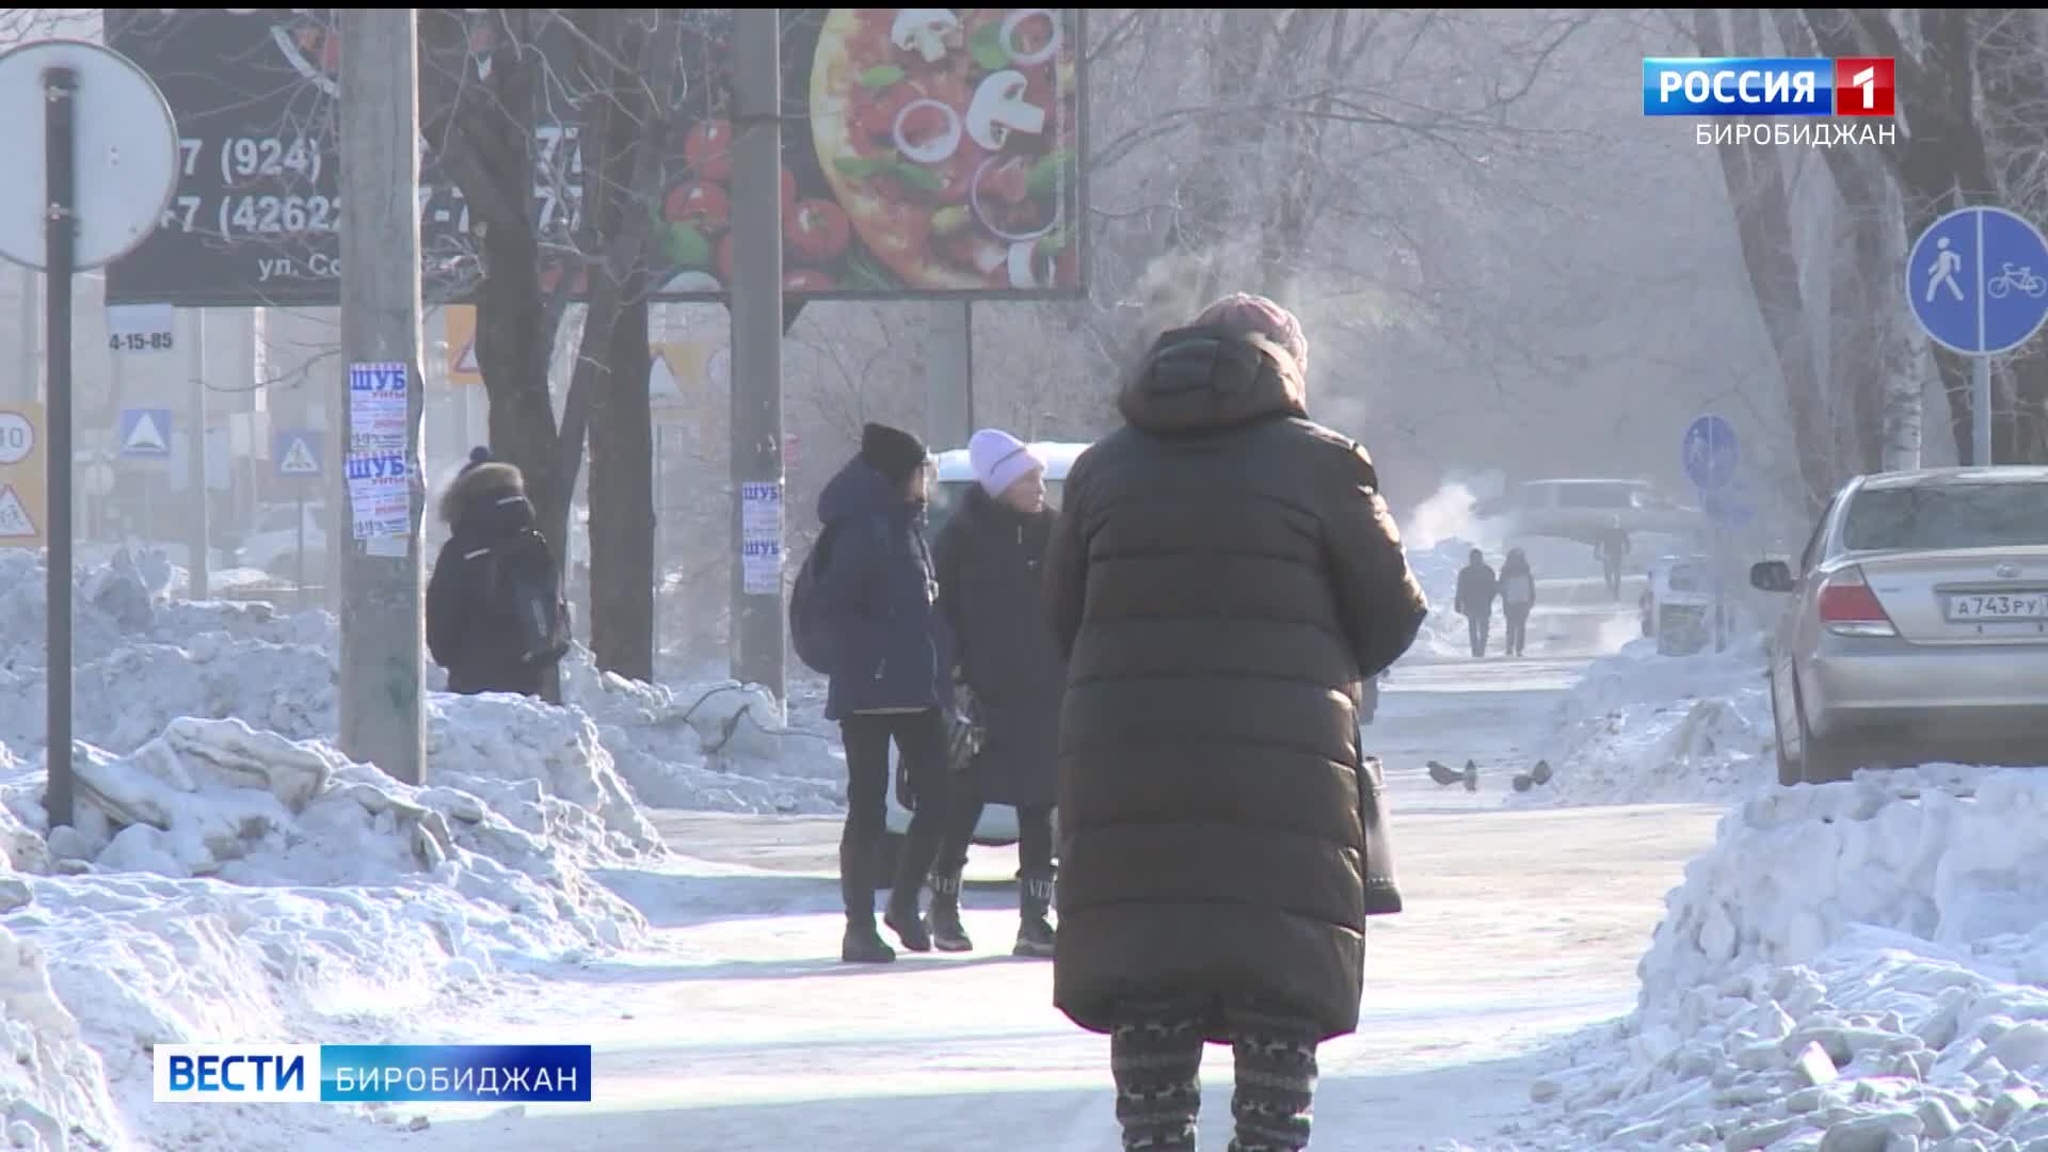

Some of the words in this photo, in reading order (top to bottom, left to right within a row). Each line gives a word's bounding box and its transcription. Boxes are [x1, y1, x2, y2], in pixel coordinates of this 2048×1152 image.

[221, 138, 321, 184] (924)
[352, 370, 405, 390] ШУБ
[349, 456, 405, 479] ШУБ
